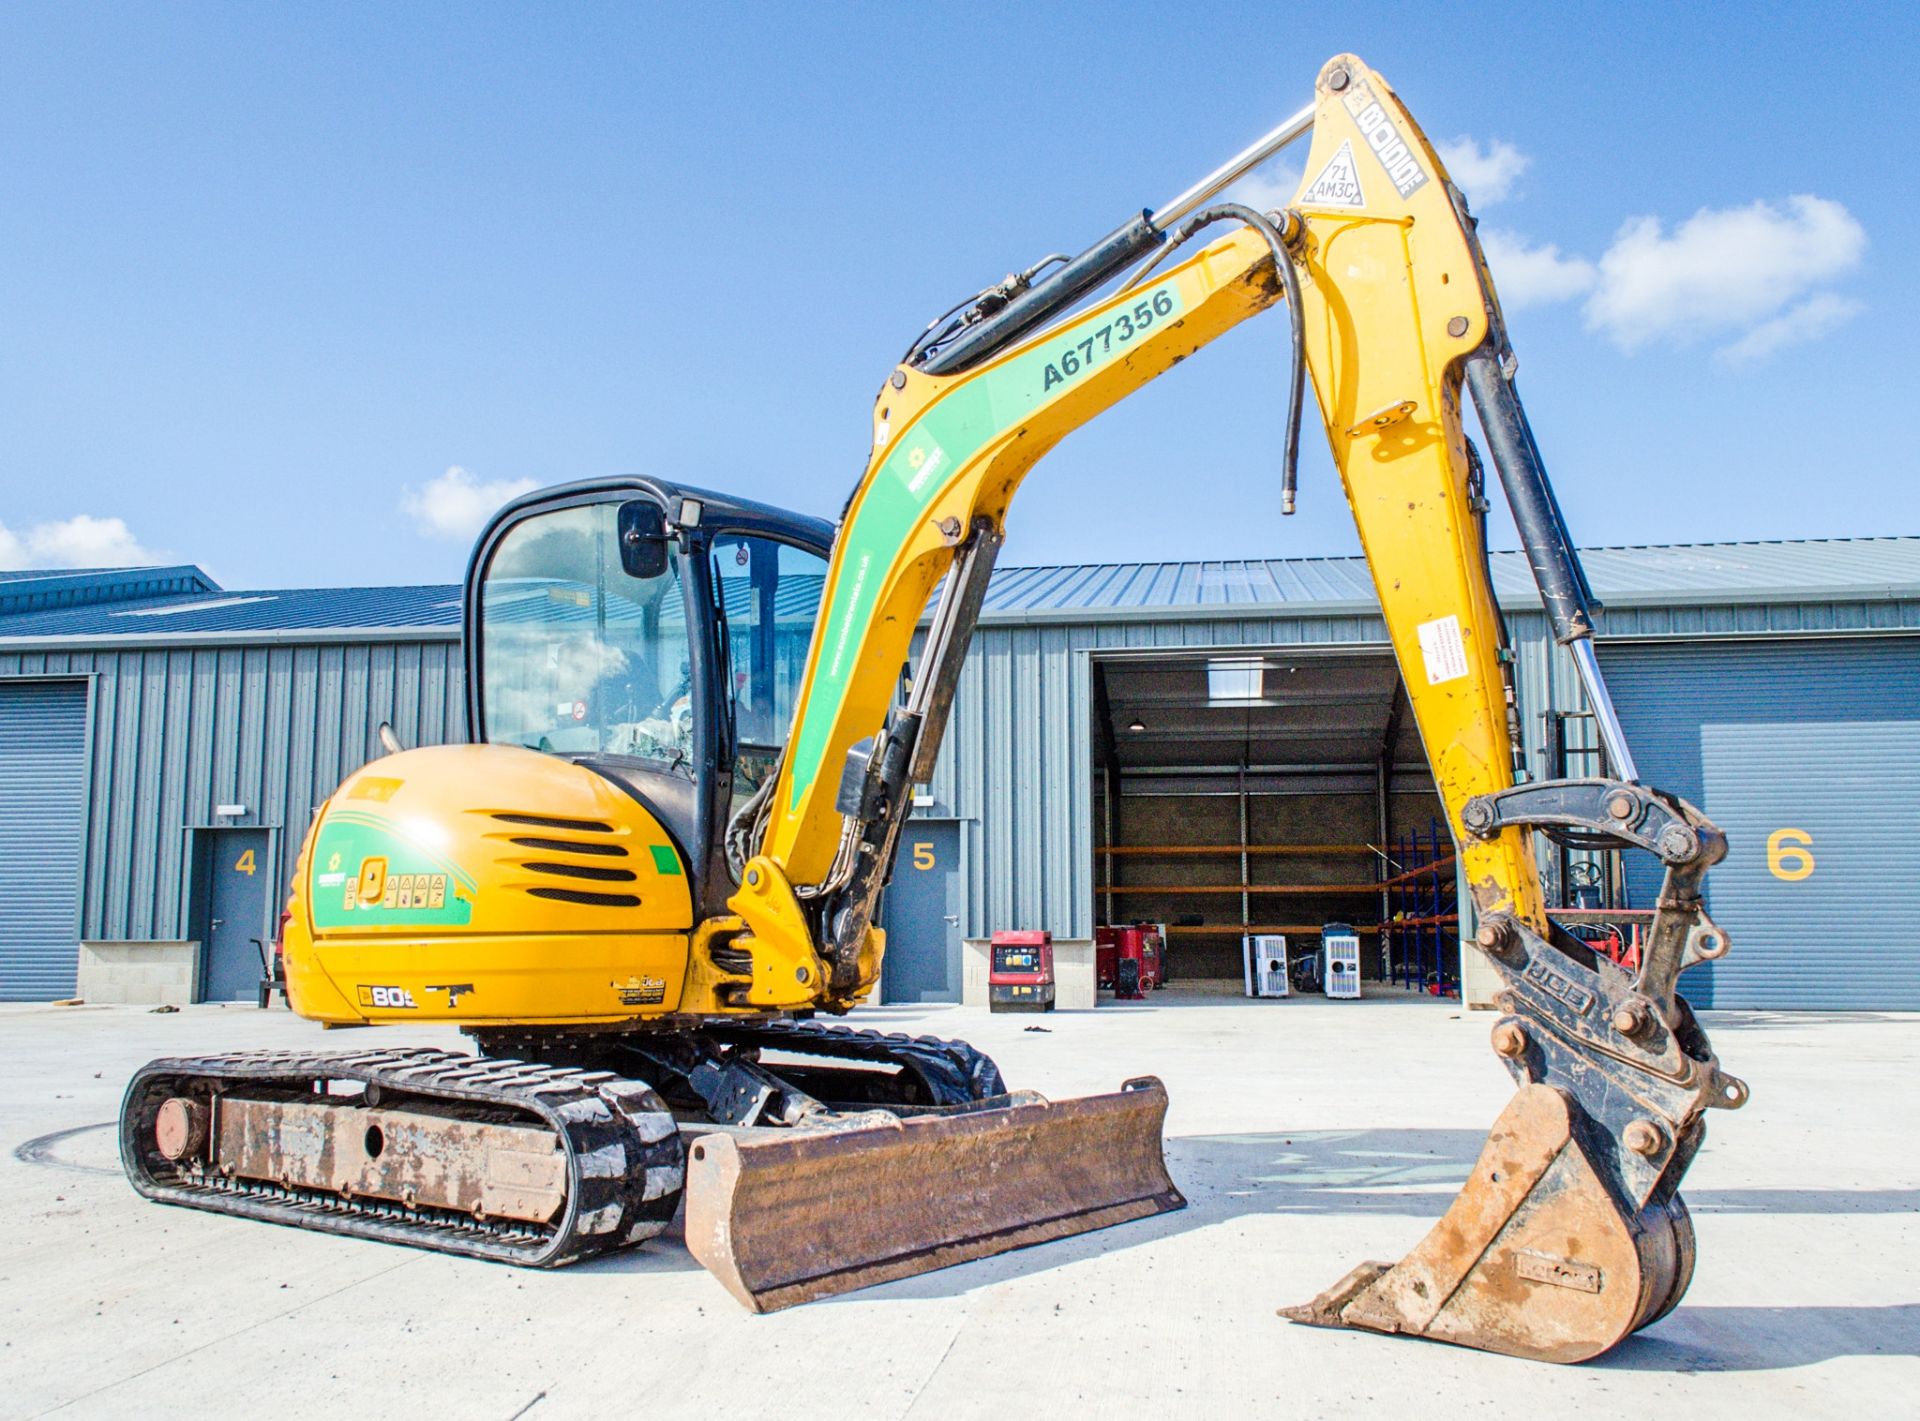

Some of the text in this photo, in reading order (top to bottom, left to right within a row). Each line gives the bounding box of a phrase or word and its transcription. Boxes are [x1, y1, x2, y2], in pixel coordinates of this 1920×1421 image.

[1354, 103, 1421, 188] 8055
[1316, 181, 1355, 199] AM3C
[1331, 165, 1348, 181] 71
[1043, 289, 1173, 392] A677356
[235, 848, 256, 876] 4
[913, 842, 936, 871] 5
[1766, 827, 1815, 881] 6
[1528, 961, 1586, 1007] JCB
